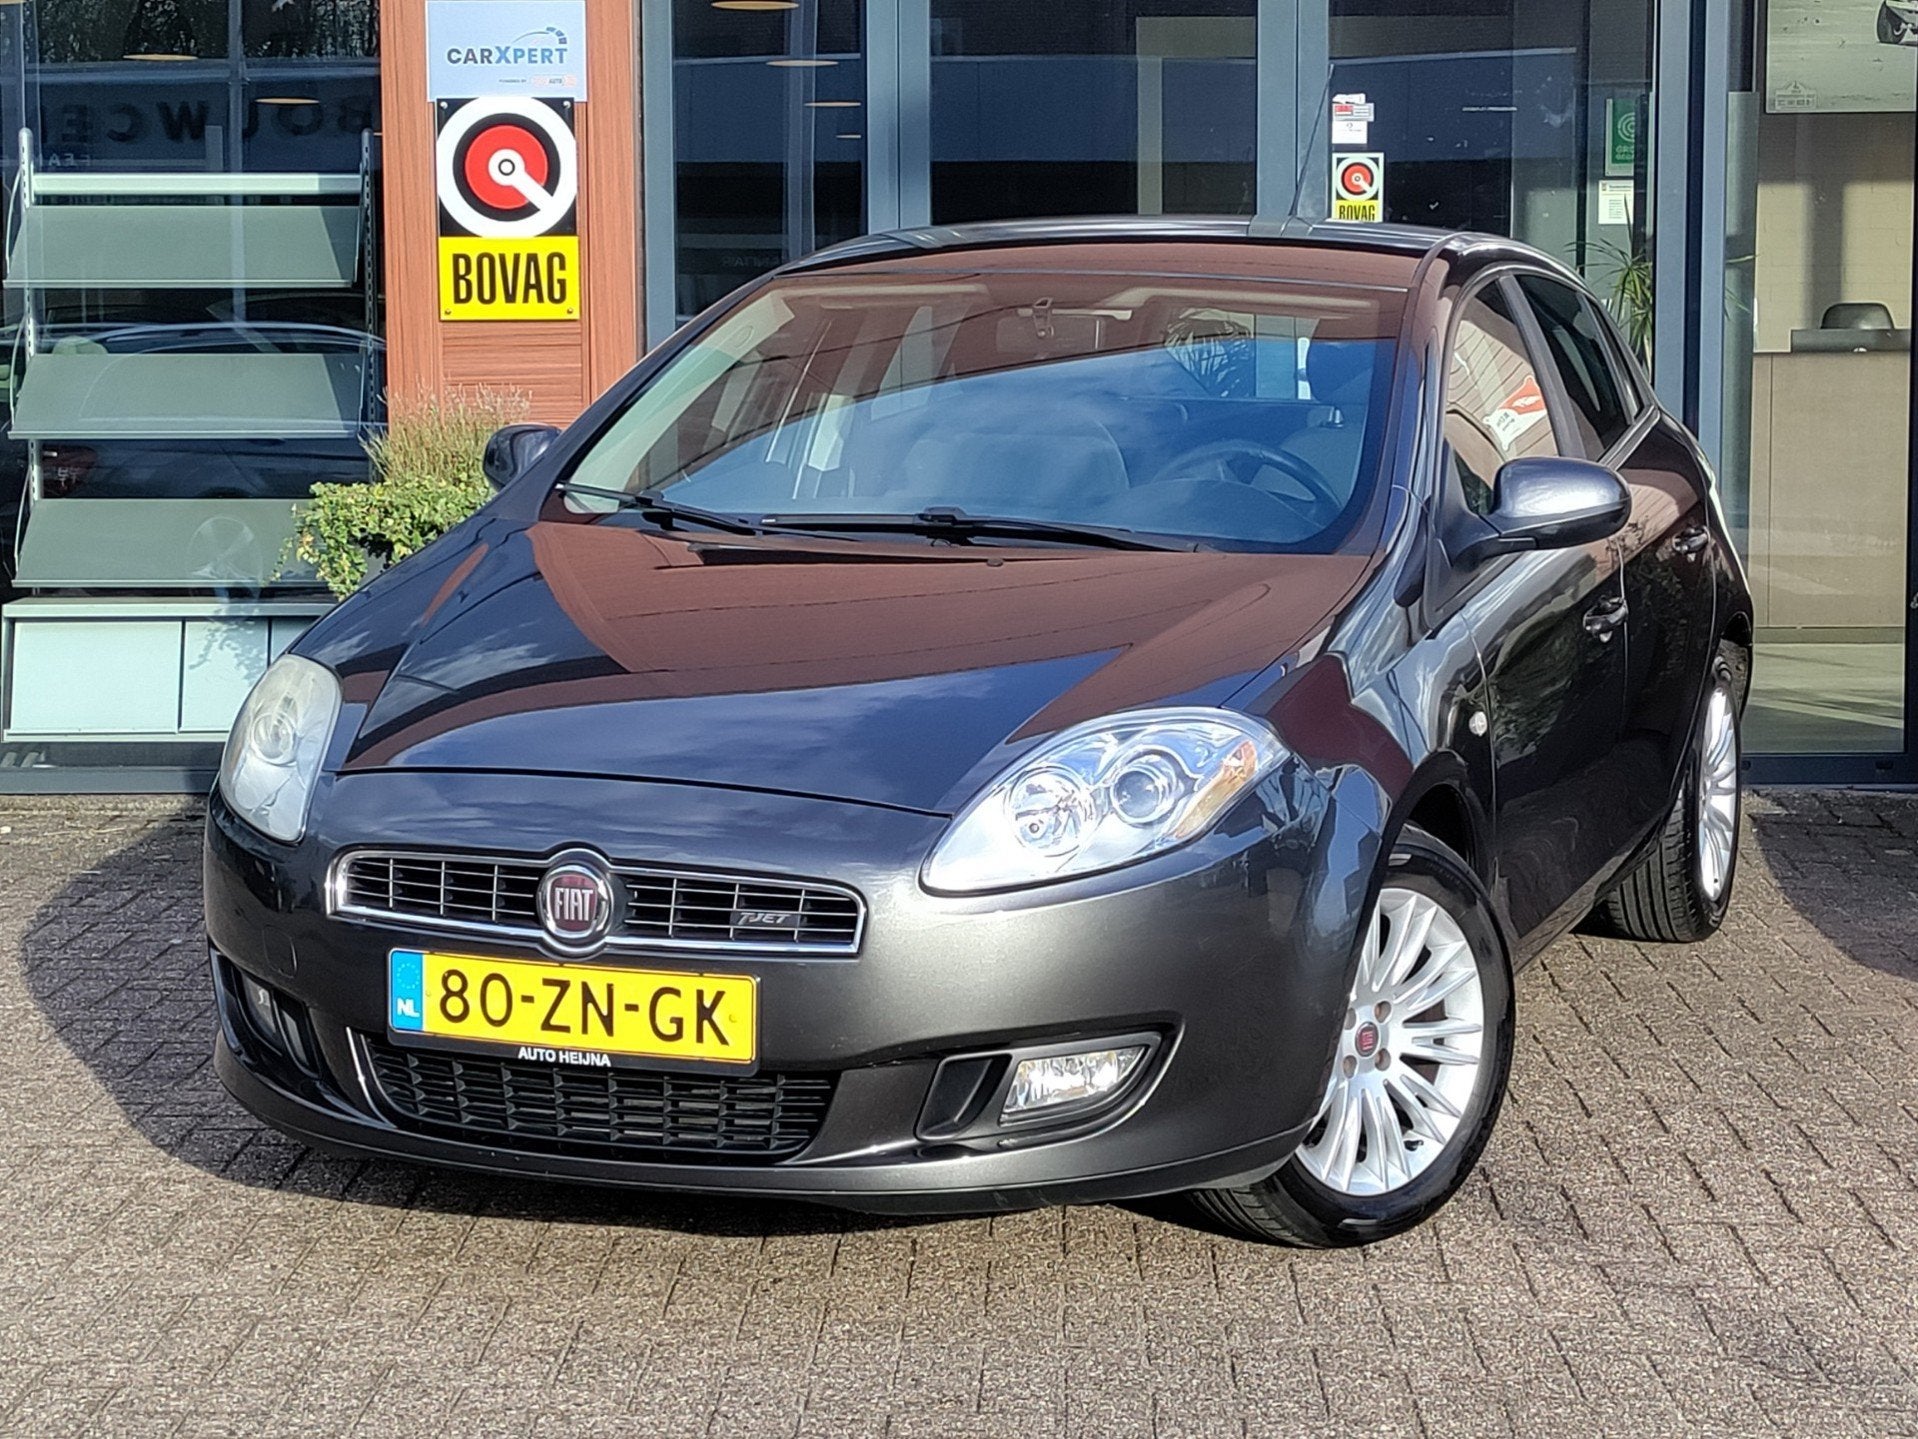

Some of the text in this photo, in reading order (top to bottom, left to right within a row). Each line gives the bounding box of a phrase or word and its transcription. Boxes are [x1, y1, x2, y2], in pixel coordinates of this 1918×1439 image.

[447, 46, 568, 64] CARXPERT
[1338, 204, 1376, 221] BOVAG
[452, 251, 567, 305] BOVAG
[555, 886, 594, 922] FIAT
[397, 998, 420, 1017] NL
[439, 969, 730, 1046] 80-ZN-GK
[518, 1046, 612, 1067] AUTO HEIJNA
